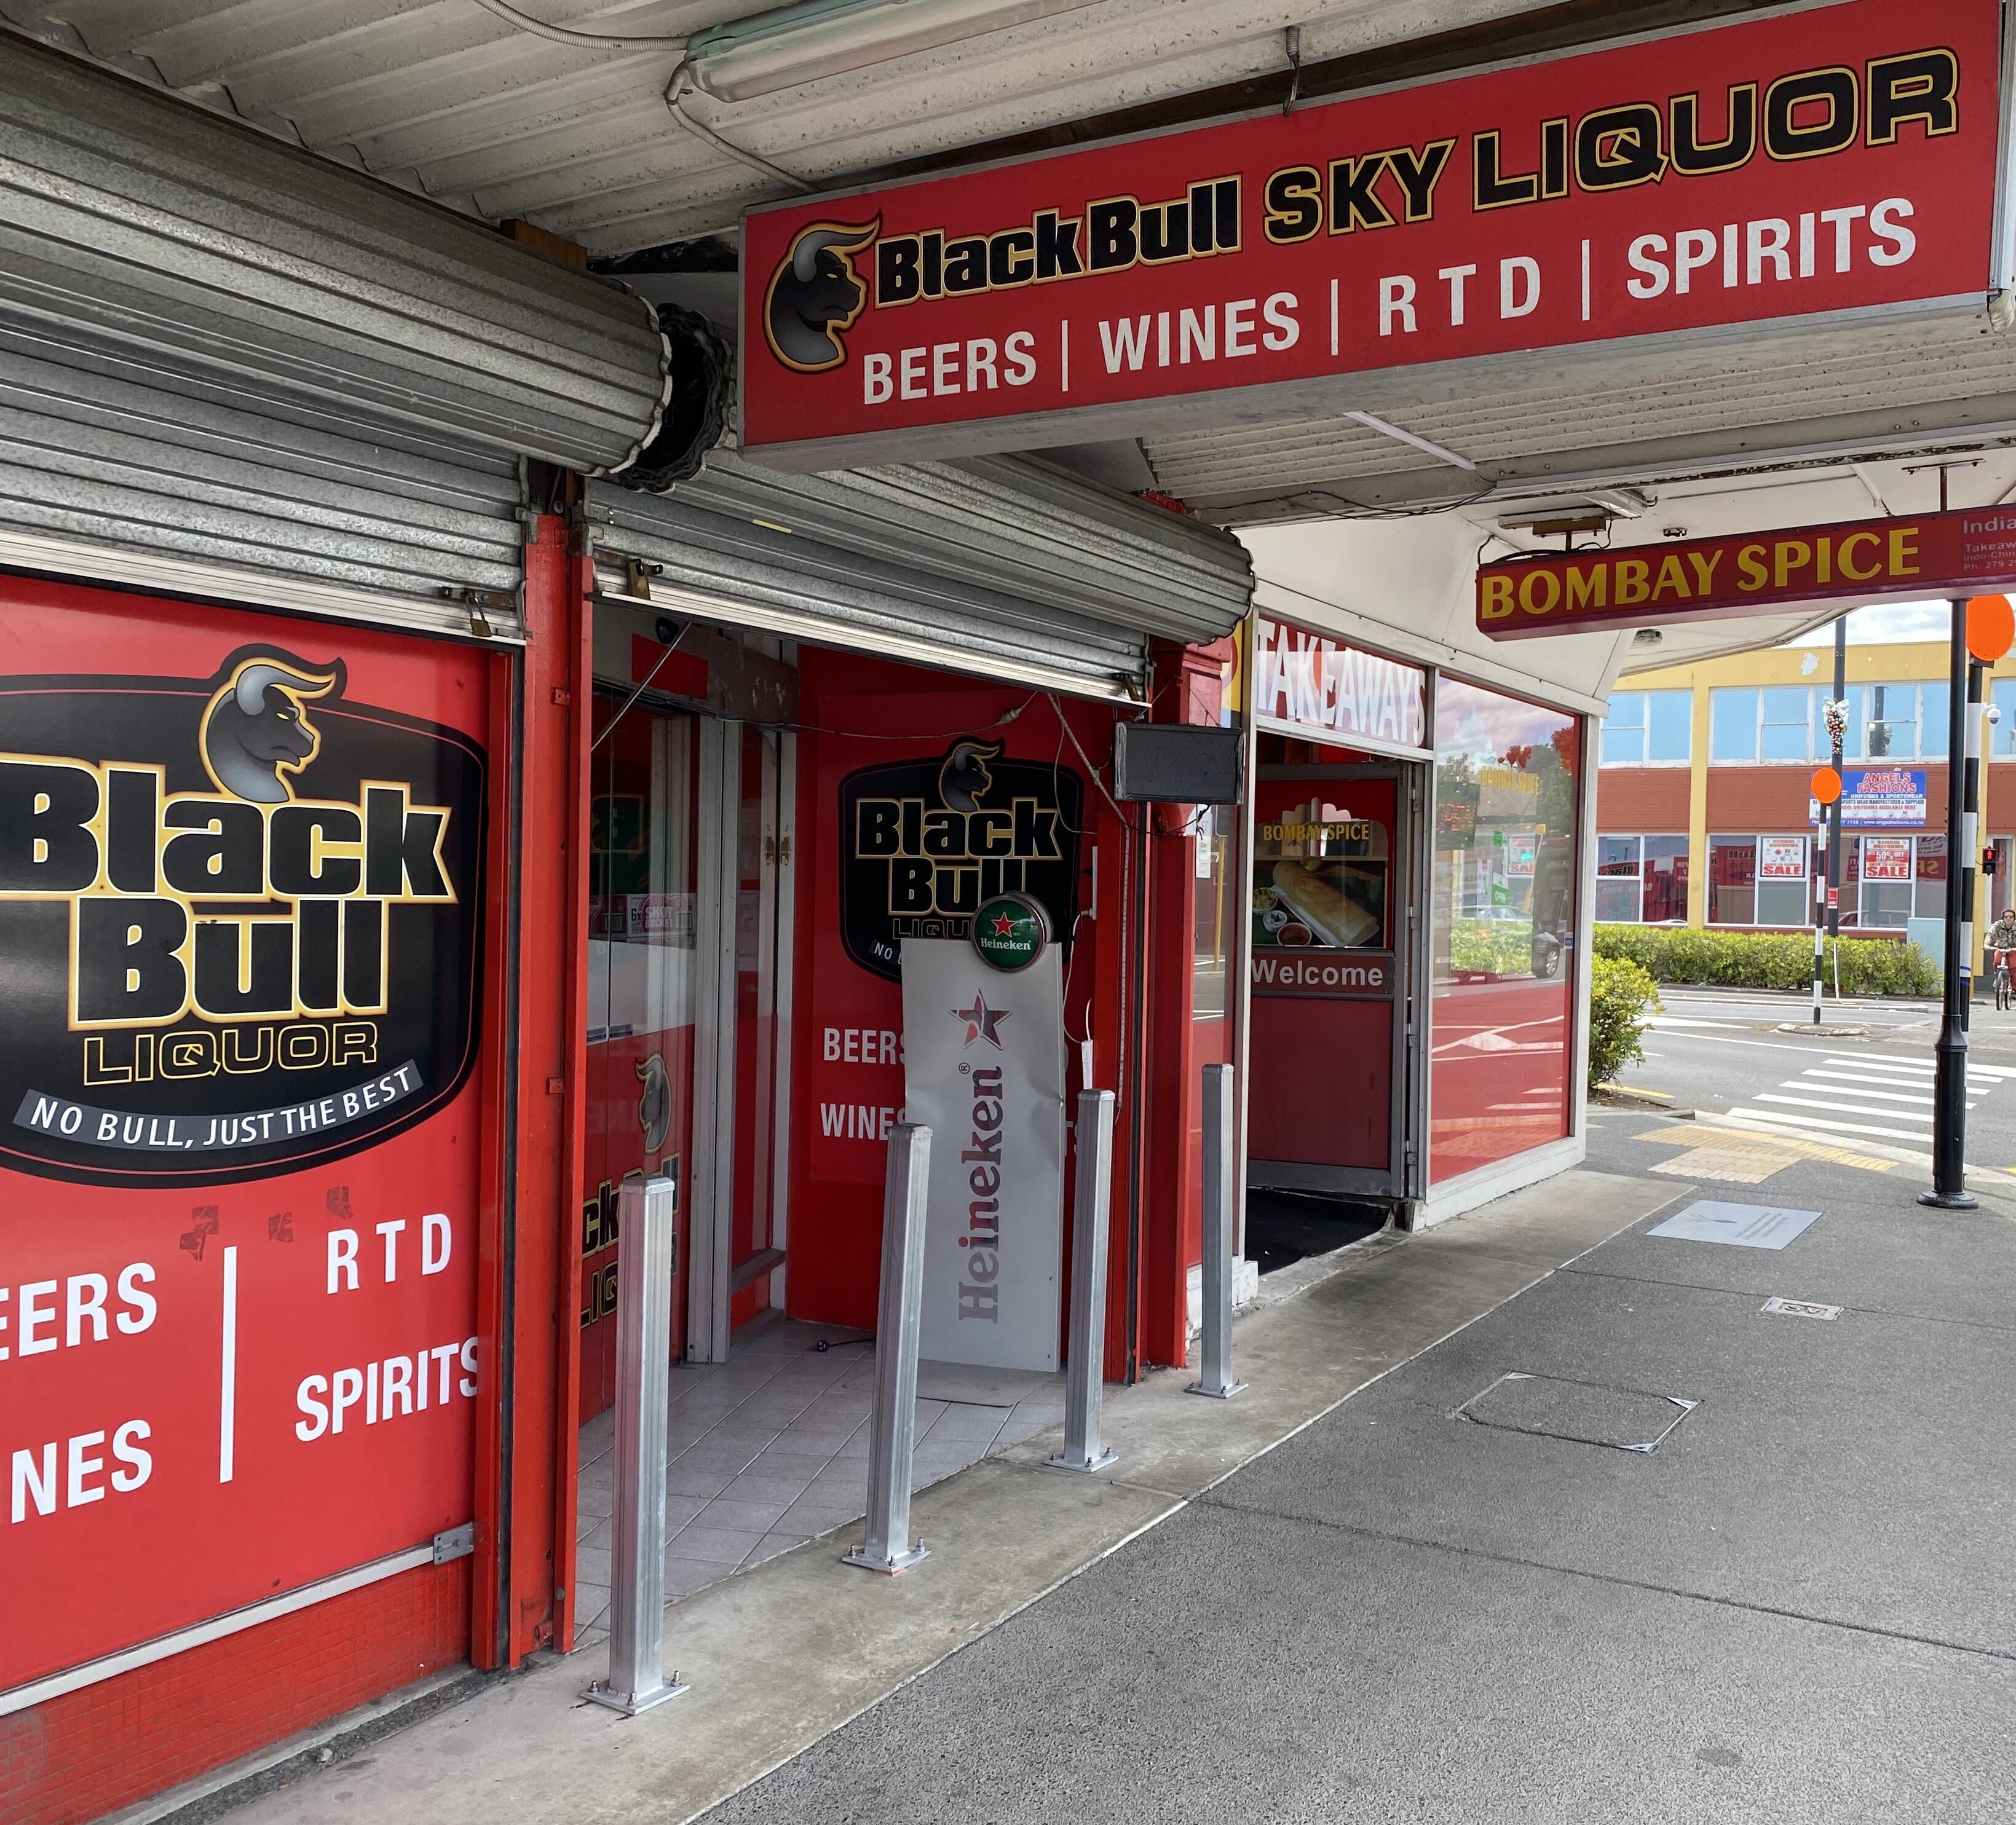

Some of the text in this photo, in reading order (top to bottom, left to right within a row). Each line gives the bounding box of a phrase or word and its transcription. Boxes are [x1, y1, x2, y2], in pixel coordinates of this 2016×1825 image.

[1263, 138, 1458, 246] SKY
[1473, 48, 1960, 213] LIQUOR
[863, 331, 1036, 404] BEERS
[1099, 291, 1300, 374] WINES
[1627, 197, 1916, 300] SPIRITS
[1482, 527, 1919, 619] BOMBAY SPICE
[1985, 560, 2004, 569] 279
[1258, 618, 1425, 747] TAKEAWAYS
[1857, 782, 1916, 794] FASHIONS
[1863, 773, 1911, 782] ANGELS
[0, 755, 458, 902] Black
[856, 798, 1064, 862] Black
[1263, 824, 1369, 841] BOMBAY SPICE
[1876, 851, 1894, 860] 50%
[888, 857, 1026, 916] Bull
[1763, 865, 1801, 875] SALE
[1867, 866, 1907, 877] SALE
[69, 897, 389, 1031] Bull
[874, 942, 892, 960] NO
[1251, 959, 1383, 986] Welcome
[84, 1021, 378, 1086] LIQUOR
[31, 1068, 411, 1150] NO BULL, JUST THE BEST
[0, 1263, 157, 1361] ERS
[11, 1419, 152, 1524] NES
